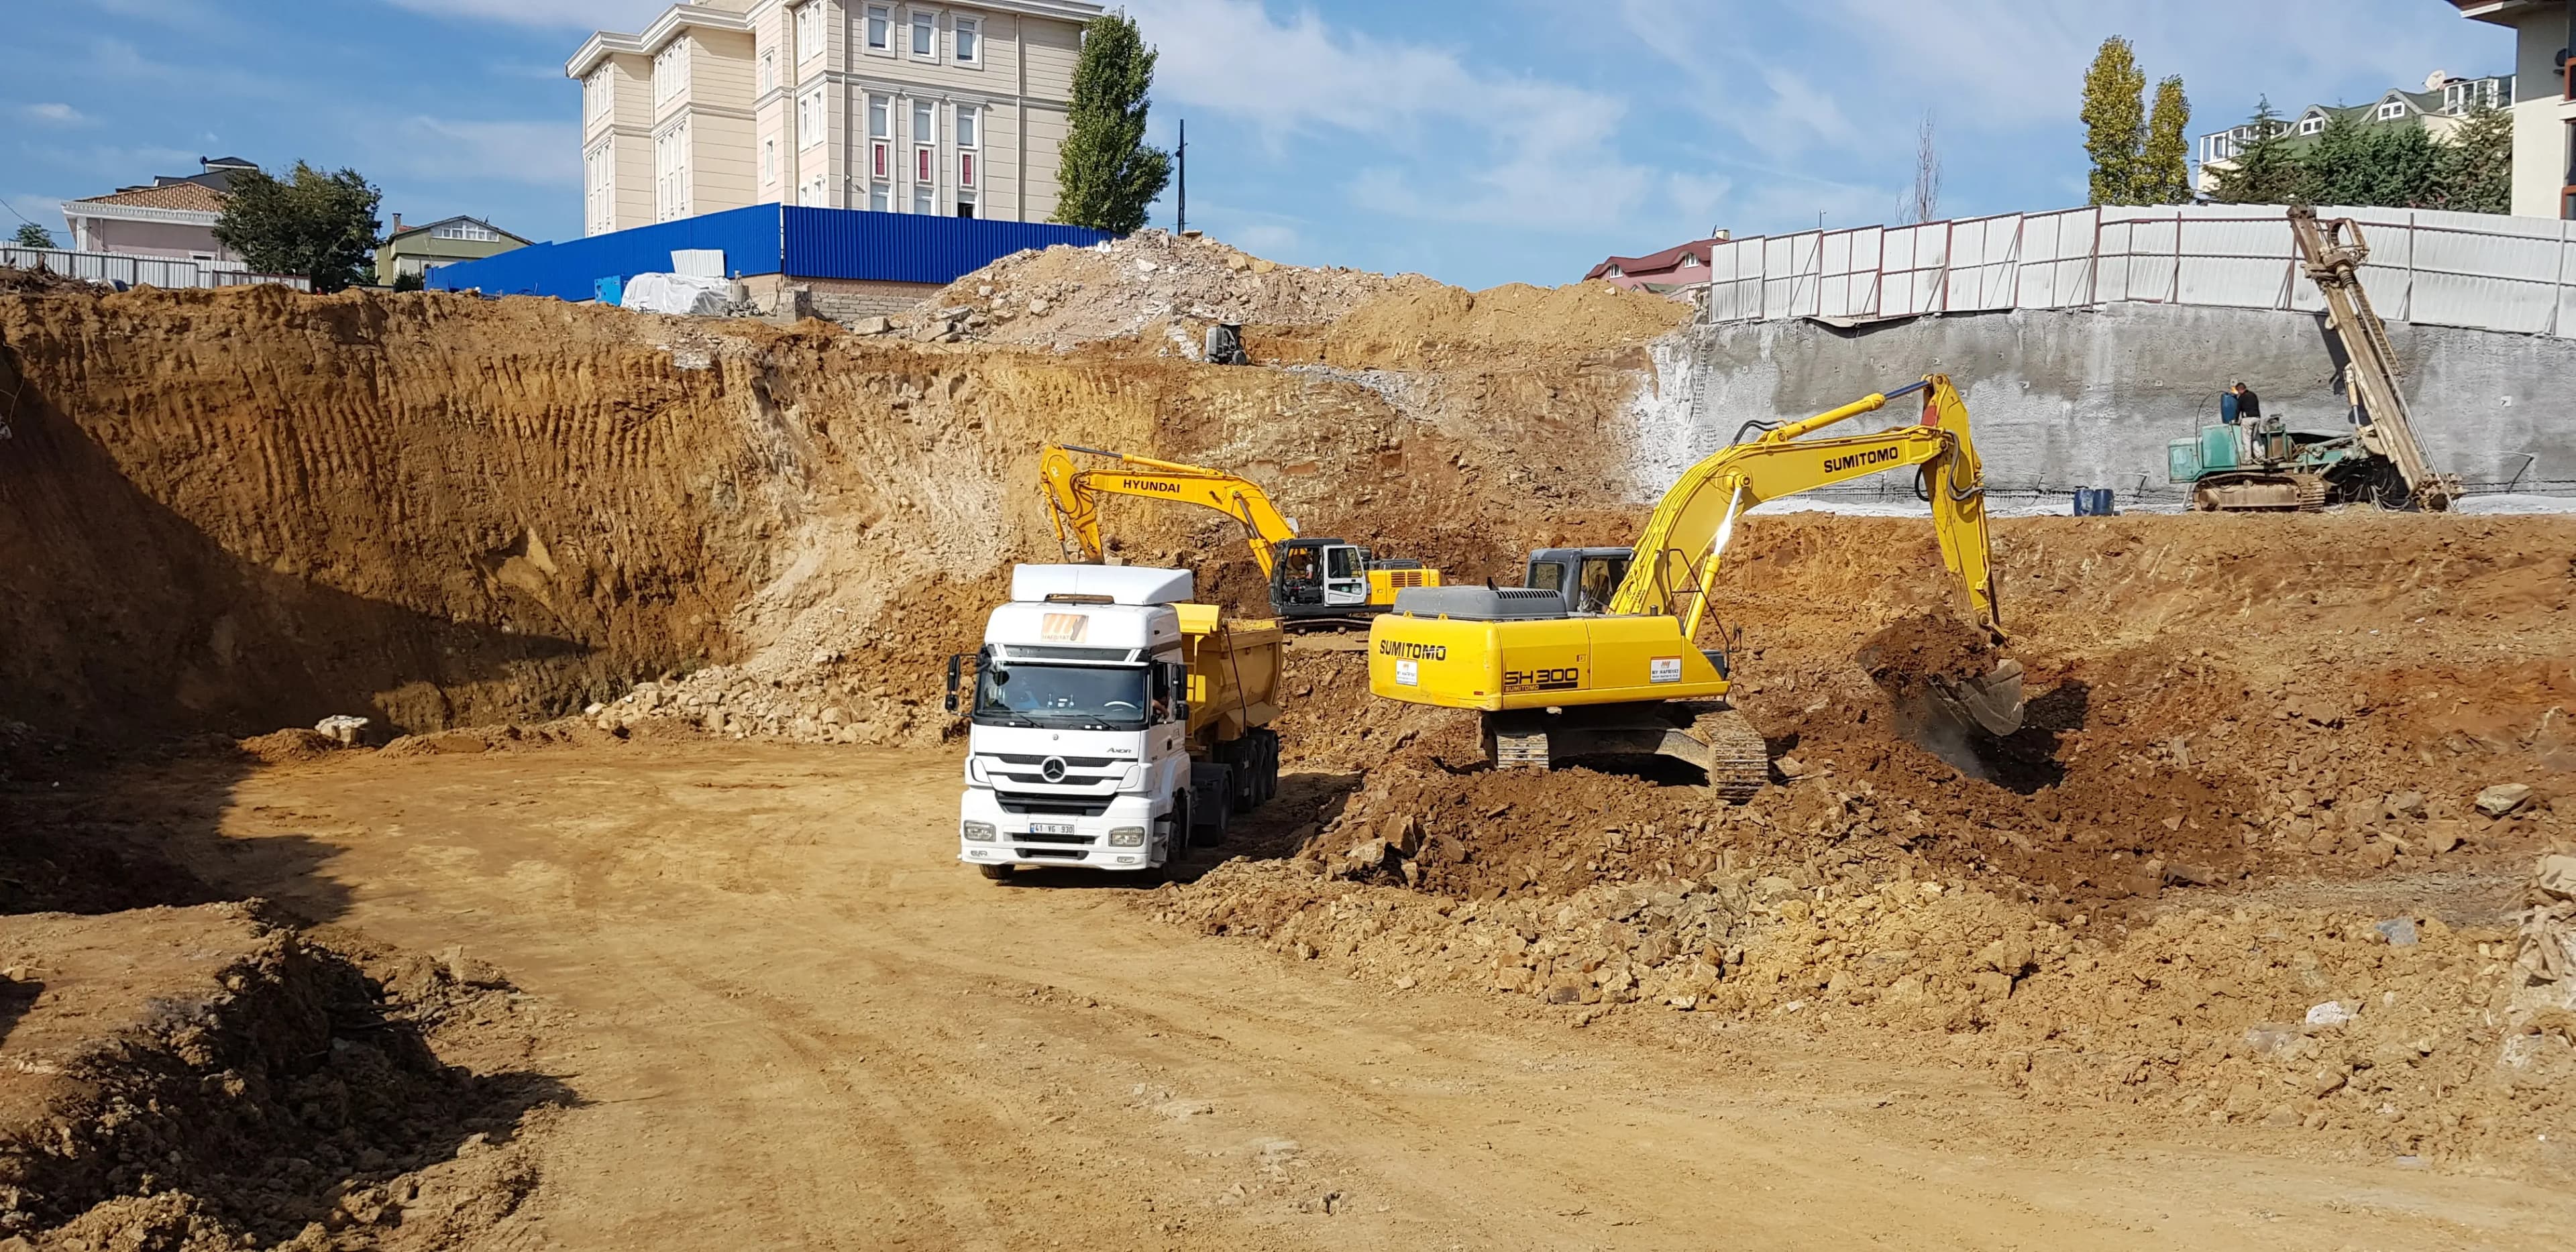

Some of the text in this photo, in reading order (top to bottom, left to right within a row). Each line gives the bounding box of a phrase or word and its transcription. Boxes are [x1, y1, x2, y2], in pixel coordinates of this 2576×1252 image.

[1823, 446, 1898, 473] SUMITOMO
[1123, 479, 1180, 494] HYUNDAI
[1379, 639, 1446, 661] SUMITOMO
[1536, 668, 1578, 683] 300
[1504, 684, 1540, 692] SUMITOMO
[1035, 823, 1042, 832] 41
[1061, 826, 1073, 834] 930
